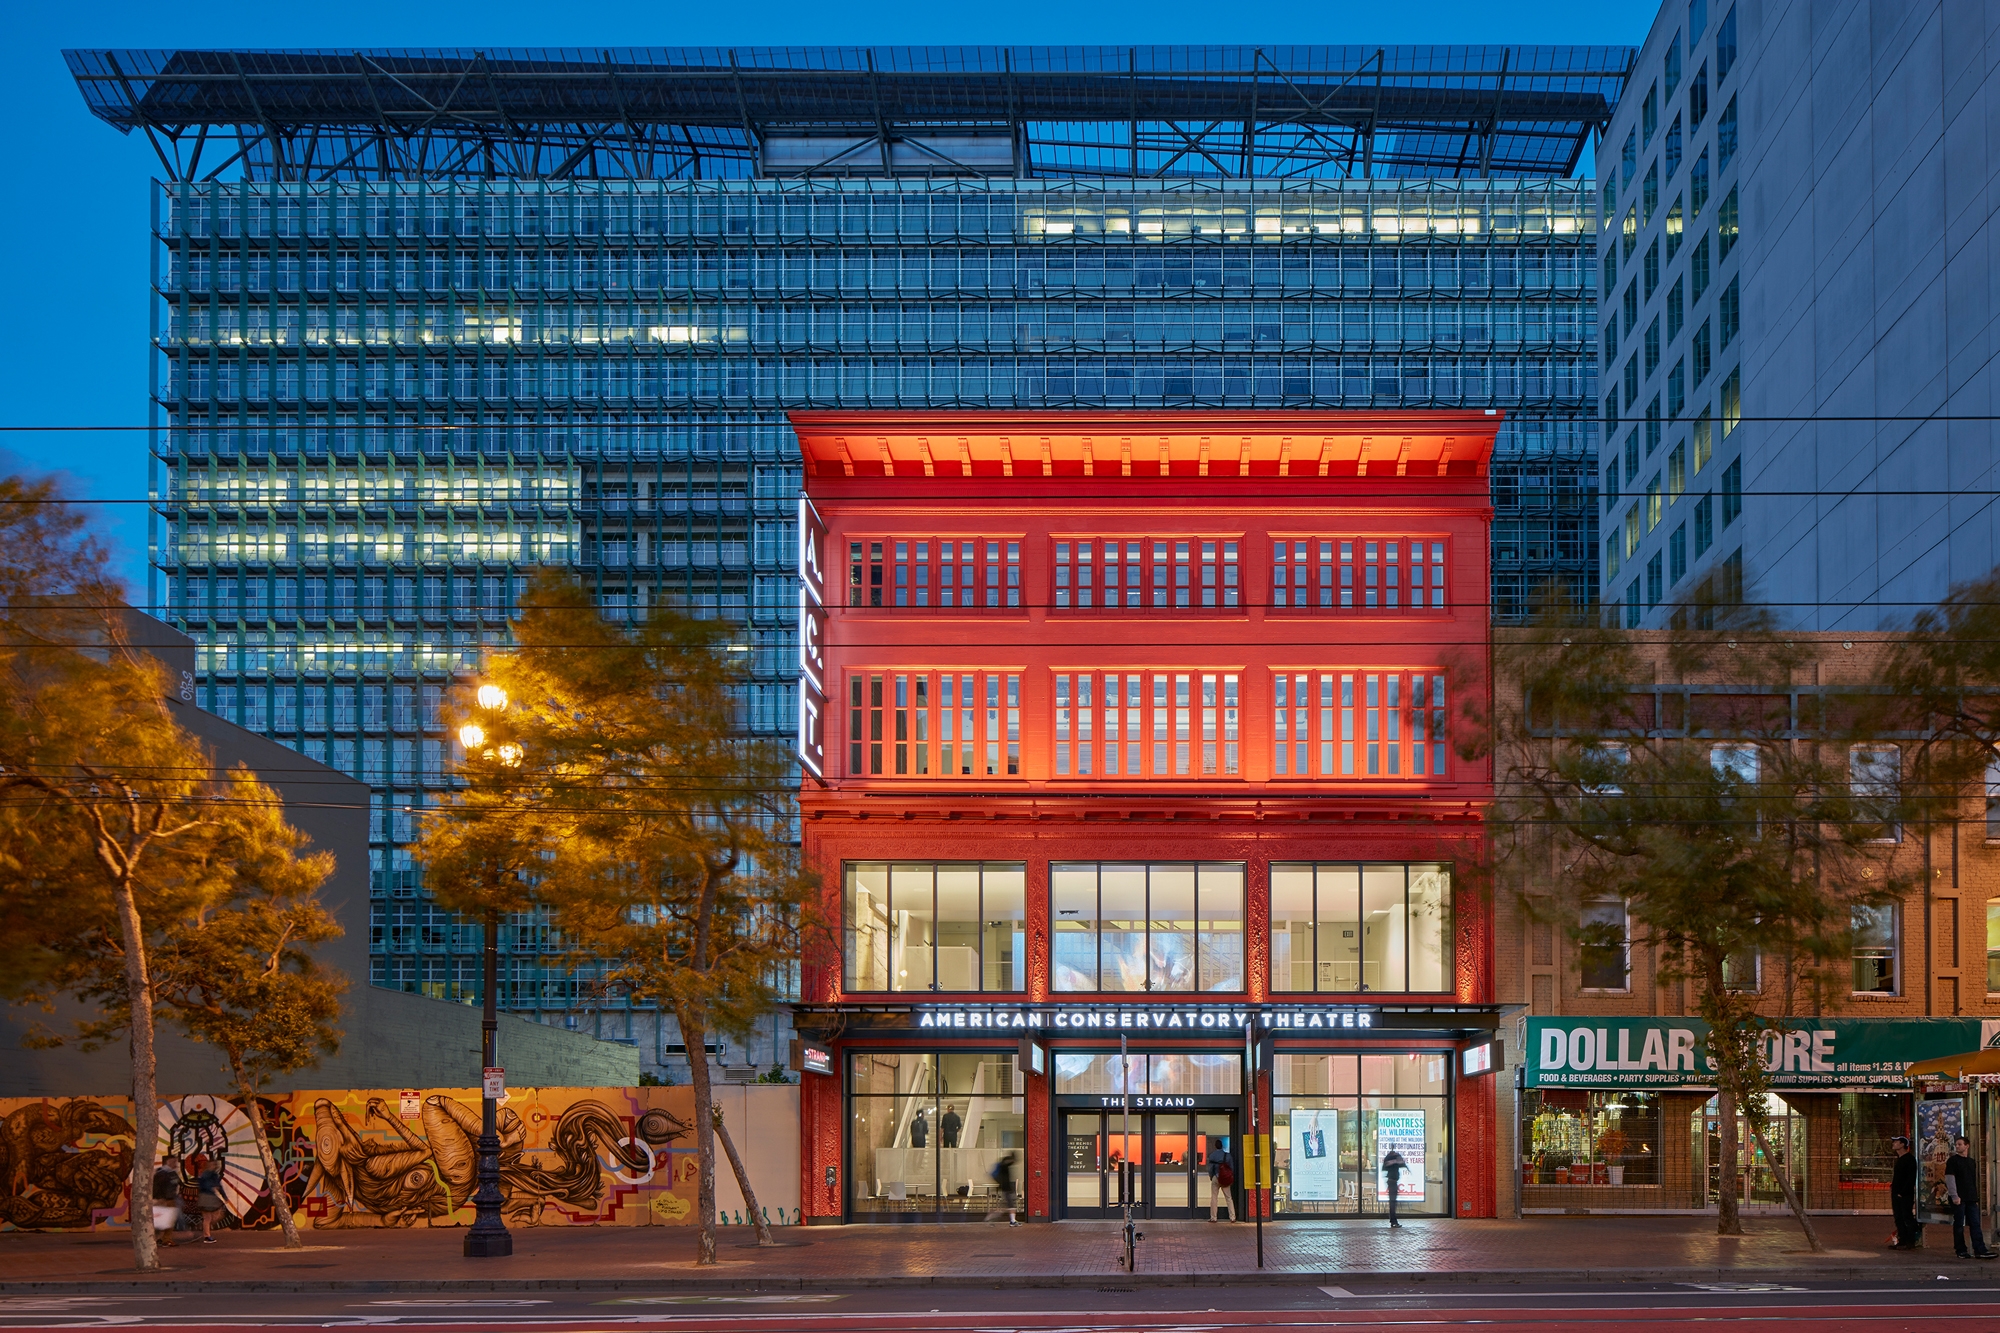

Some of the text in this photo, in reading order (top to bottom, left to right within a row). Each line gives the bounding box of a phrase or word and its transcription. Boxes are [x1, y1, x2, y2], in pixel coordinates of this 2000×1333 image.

[920, 1013, 1371, 1027] AMERICAN CONSERVATORY THEATER
[1539, 1027, 1695, 1071] DOLLAR
[1837, 1062, 1847, 1072] all
[1850, 1062, 1871, 1072] items
[1873, 1061, 1893, 1072] $1.25
[1895, 1061, 1901, 1071] &
[1539, 1074, 1559, 1082] FOOD
[1561, 1074, 1567, 1082] &
[1569, 1074, 1612, 1083] BEVERAGES
[1619, 1074, 1643, 1083] PARTY
[1645, 1074, 1679, 1083] SUPPLIES
[1798, 1075, 1833, 1084] SUPPLIES
[1839, 1075, 1867, 1084] SCHOOL
[1869, 1075, 1903, 1084] SUPPLIES
[1136, 1097, 1195, 1107] STRAND
[1379, 1118, 1424, 1128] MONSTRESS
[1294, 1162, 1336, 1171] LOVE
